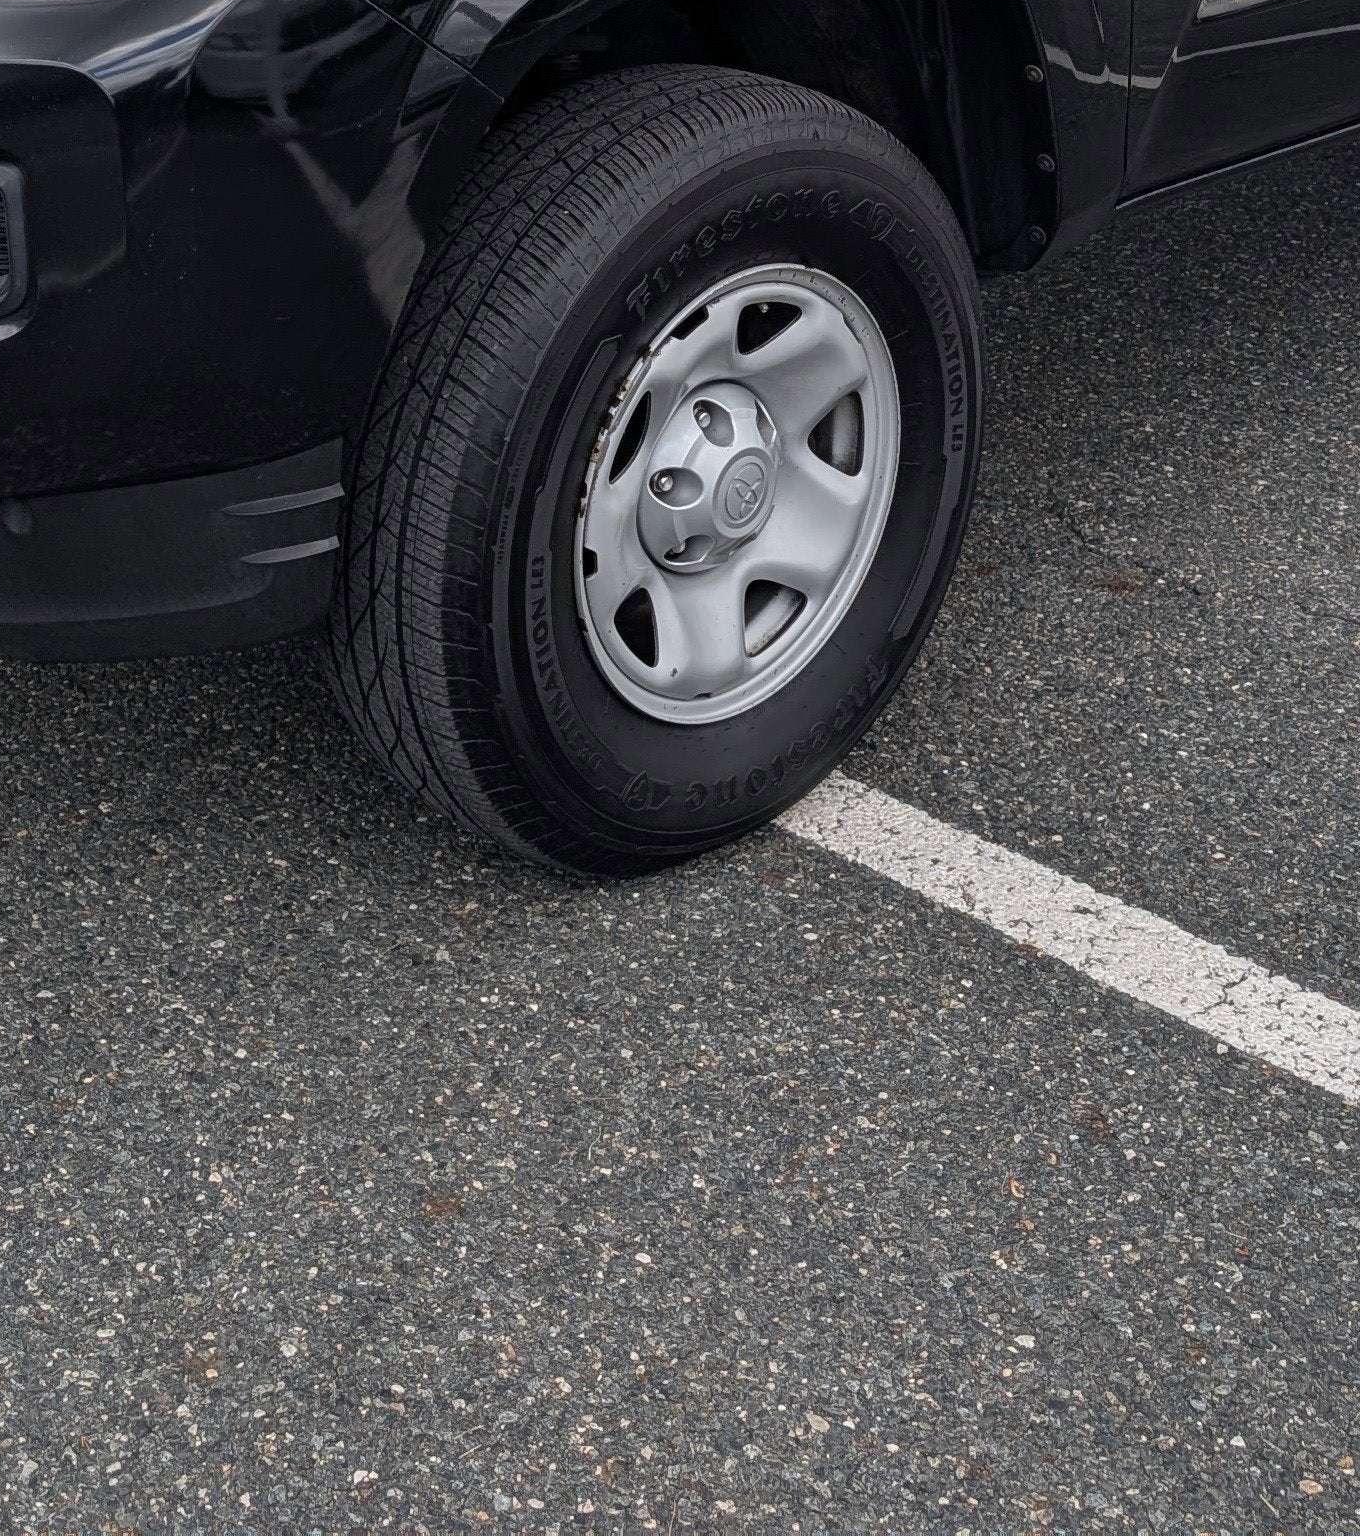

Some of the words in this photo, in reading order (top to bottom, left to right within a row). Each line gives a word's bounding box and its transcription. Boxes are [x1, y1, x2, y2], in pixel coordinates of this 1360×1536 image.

[626, 188, 840, 321] Firestone
[906, 245, 963, 417] DESTINATION
[951, 424, 964, 453] LE3
[530, 555, 544, 589] LE3
